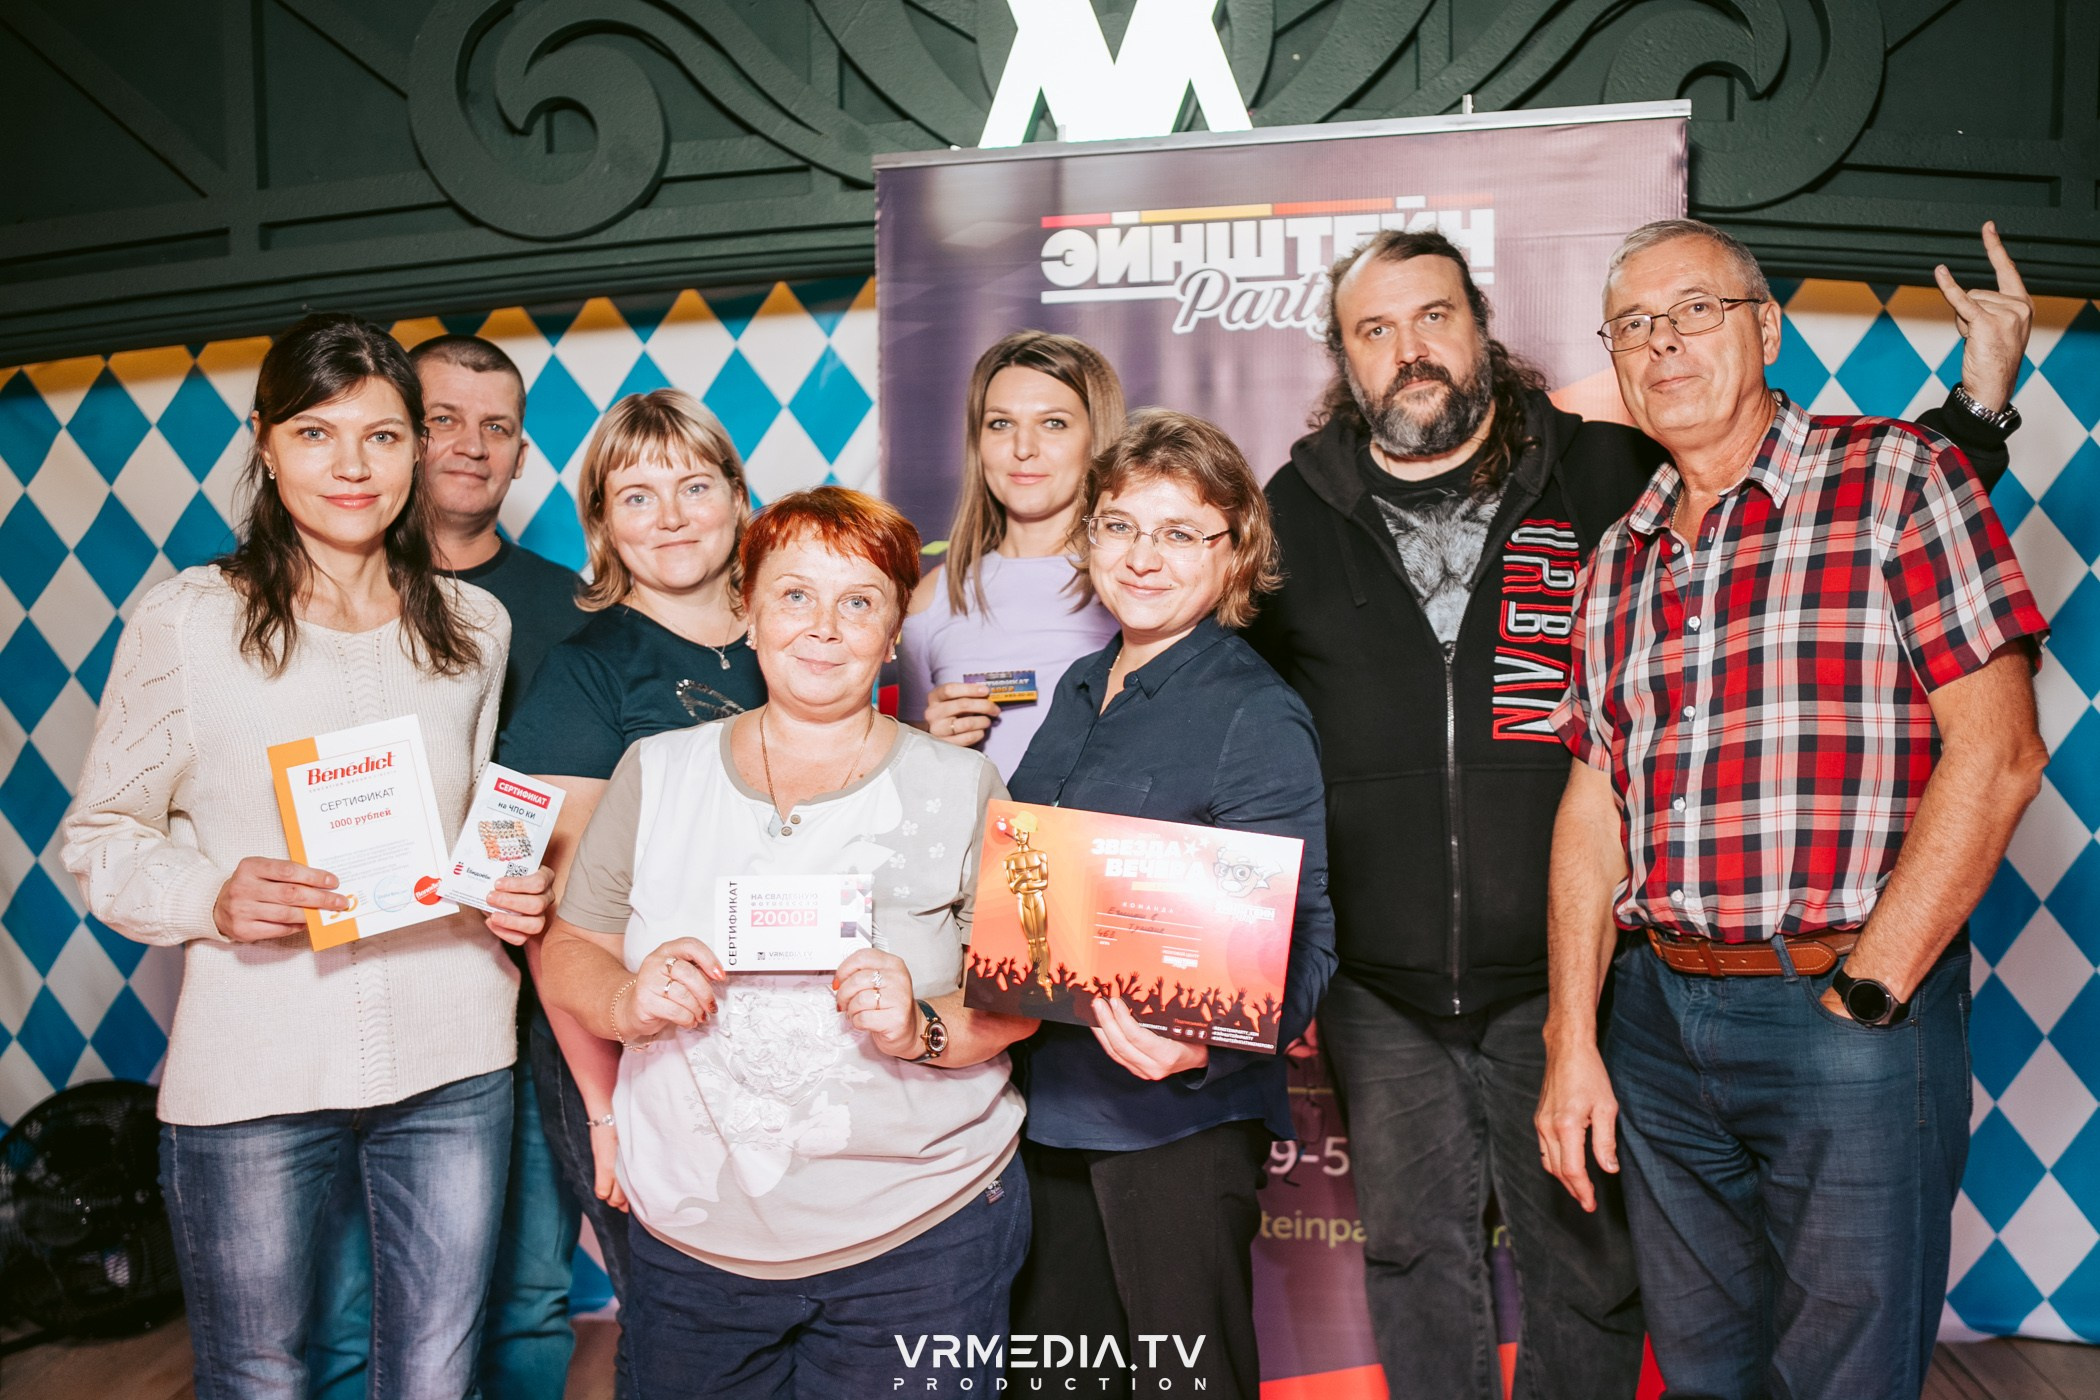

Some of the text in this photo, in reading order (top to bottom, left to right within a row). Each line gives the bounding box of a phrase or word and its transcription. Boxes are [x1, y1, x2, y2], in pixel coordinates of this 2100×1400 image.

[1492, 518, 1581, 743] URBAN
[320, 787, 395, 813] СЕРТИФИКАТ
[498, 782, 548, 806] СЕРТИФИКАТ
[330, 808, 392, 829] 1000 рублей
[509, 804, 525, 815] ЧПО
[525, 811, 536, 819] КИ
[1091, 838, 1182, 858] ЗВЕЗДА
[1105, 858, 1207, 881] ВЕЧЕРА
[751, 893, 764, 901] НА
[1122, 901, 1174, 914] КОМАНДА
[728, 880, 739, 966] СЕРТИФИКАТ
